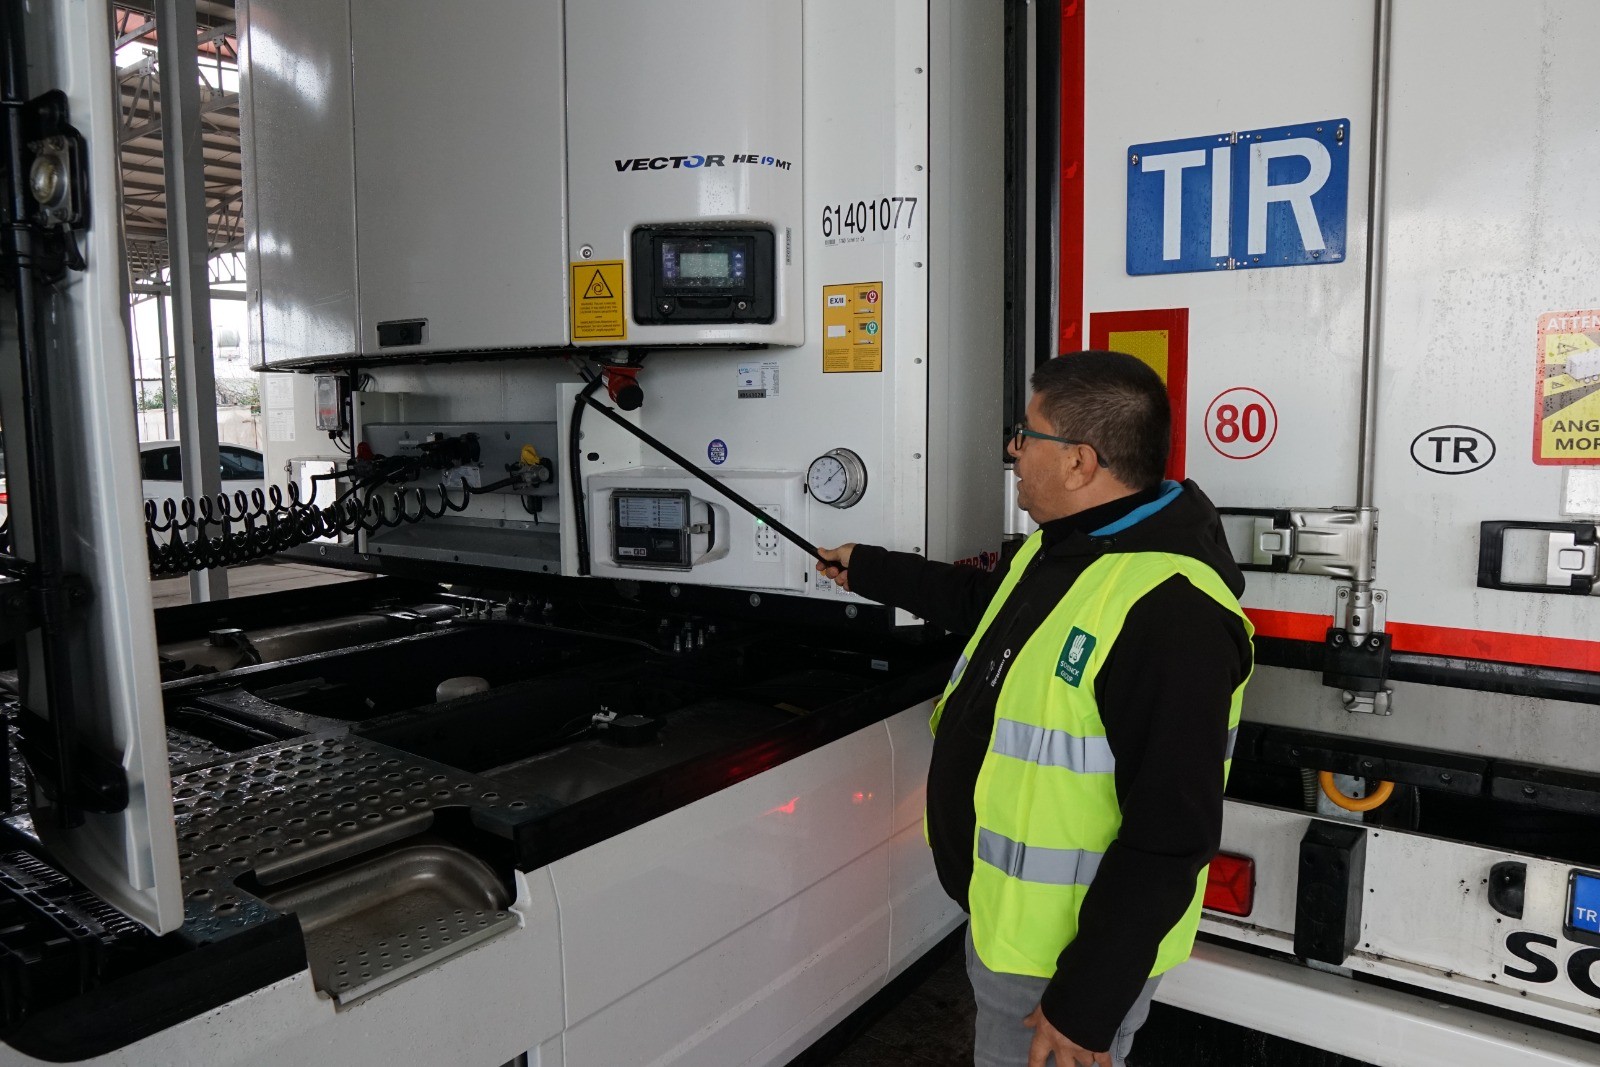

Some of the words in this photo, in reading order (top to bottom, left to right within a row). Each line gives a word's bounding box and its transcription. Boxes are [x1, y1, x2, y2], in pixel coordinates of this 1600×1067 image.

[614, 154, 726, 173] VECTOR
[732, 154, 760, 164] HE
[761, 156, 775, 166] 19
[775, 160, 792, 171] MT
[1141, 137, 1332, 261] TIR
[822, 196, 918, 238] 61401077
[1215, 403, 1267, 444] 80
[1551, 419, 1600, 433] ANG
[1428, 436, 1479, 464] TR
[1576, 906, 1598, 923] TR
